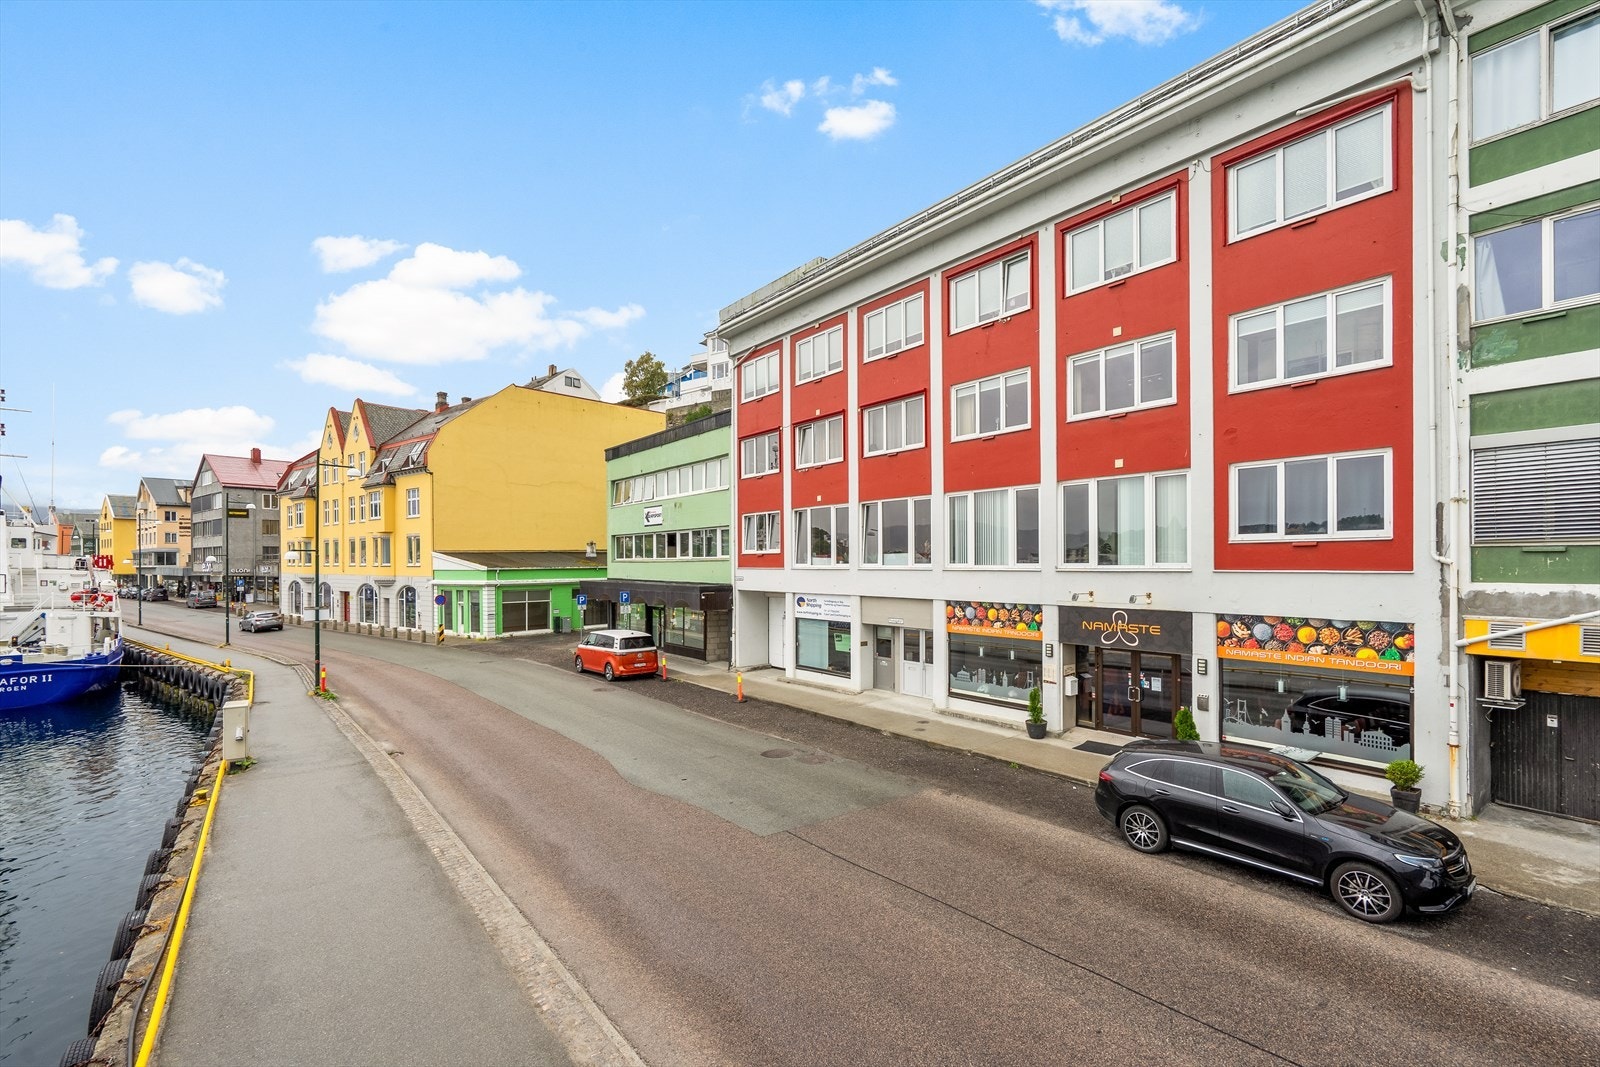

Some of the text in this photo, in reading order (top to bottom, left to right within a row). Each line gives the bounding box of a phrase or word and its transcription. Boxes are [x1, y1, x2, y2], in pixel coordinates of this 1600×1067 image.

[951, 625, 1040, 638] NAMASTE INDIAN TANDOORI
[1082, 620, 1161, 635] NAMASTE
[1225, 648, 1402, 671] NAMASTE INDIAN TANDOORI
